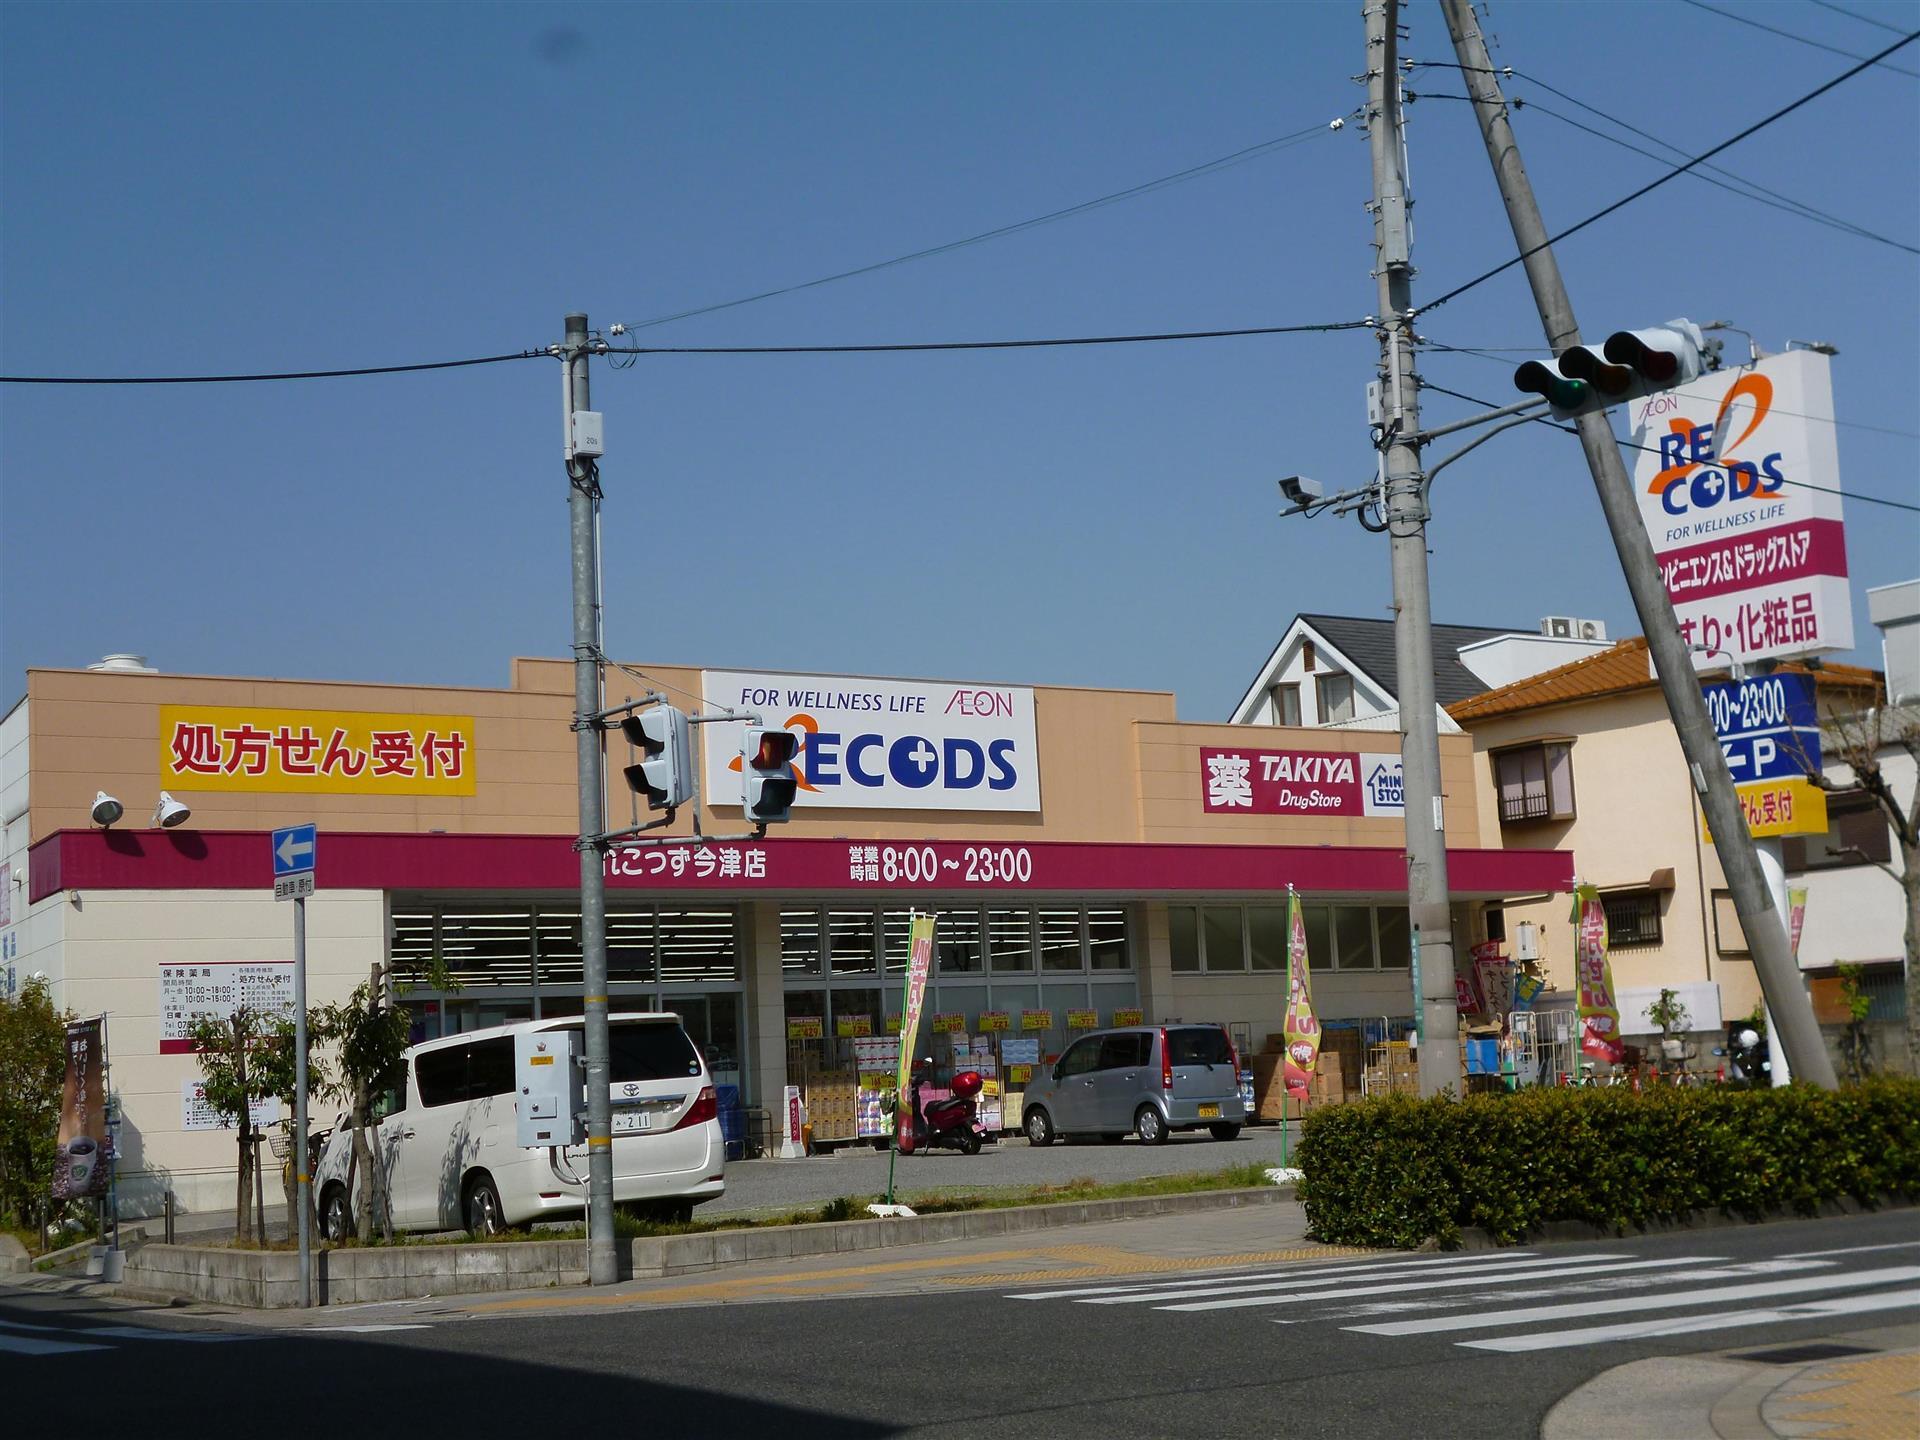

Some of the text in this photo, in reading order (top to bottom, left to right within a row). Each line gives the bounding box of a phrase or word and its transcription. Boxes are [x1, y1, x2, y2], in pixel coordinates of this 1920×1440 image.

[1665, 503, 1786, 543] FOR WELLNESS LIFE
[740, 688, 926, 714] FOR WELLNESS LIFE
[171, 721, 467, 779] 処方せん受付
[792, 728, 1018, 792] ECODS
[1259, 755, 1355, 784] TAKIYA
[1752, 737, 1777, 777] P
[1206, 754, 1253, 807] 薬
[163, 968, 211, 979] 保険薬局
[239, 974, 292, 984] 処方せん受付
